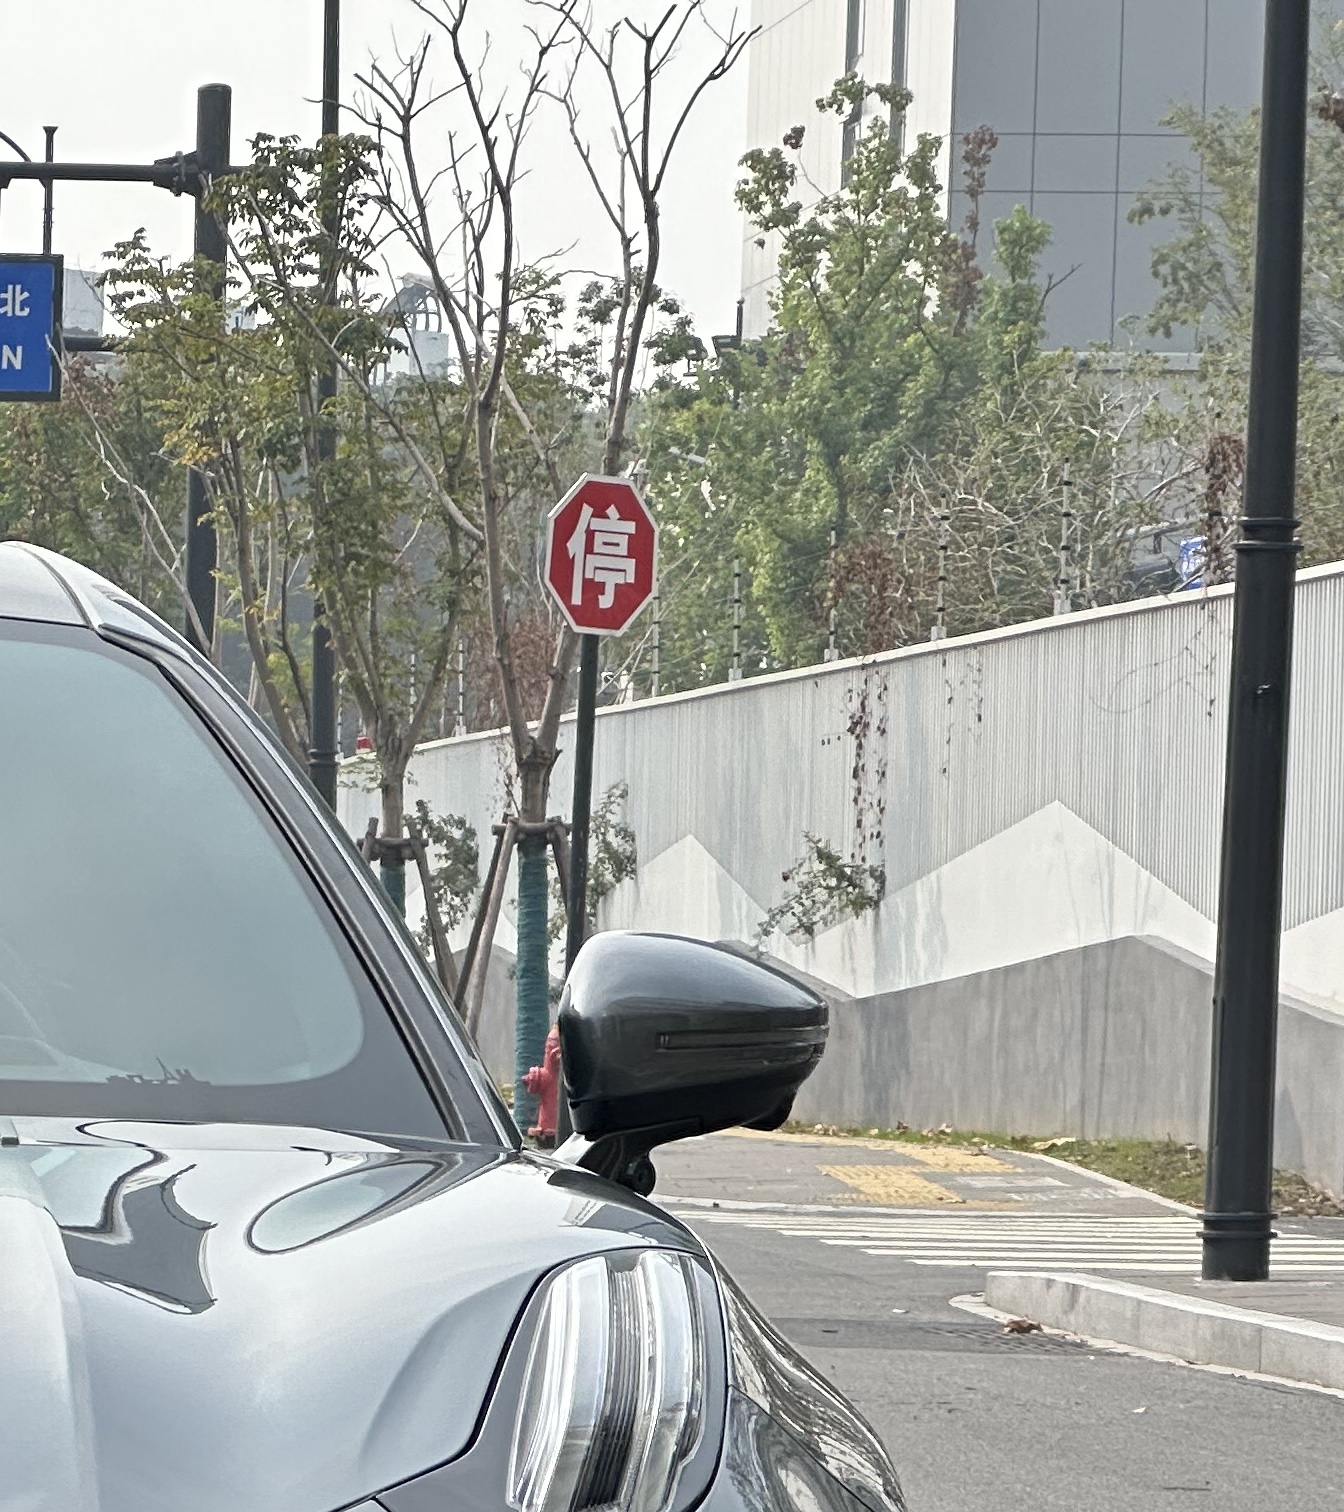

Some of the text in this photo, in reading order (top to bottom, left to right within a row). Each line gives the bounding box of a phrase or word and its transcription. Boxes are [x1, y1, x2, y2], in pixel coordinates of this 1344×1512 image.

[0, 284, 30, 317] 北
[1, 345, 22, 370] N
[566, 502, 636, 609] 停
